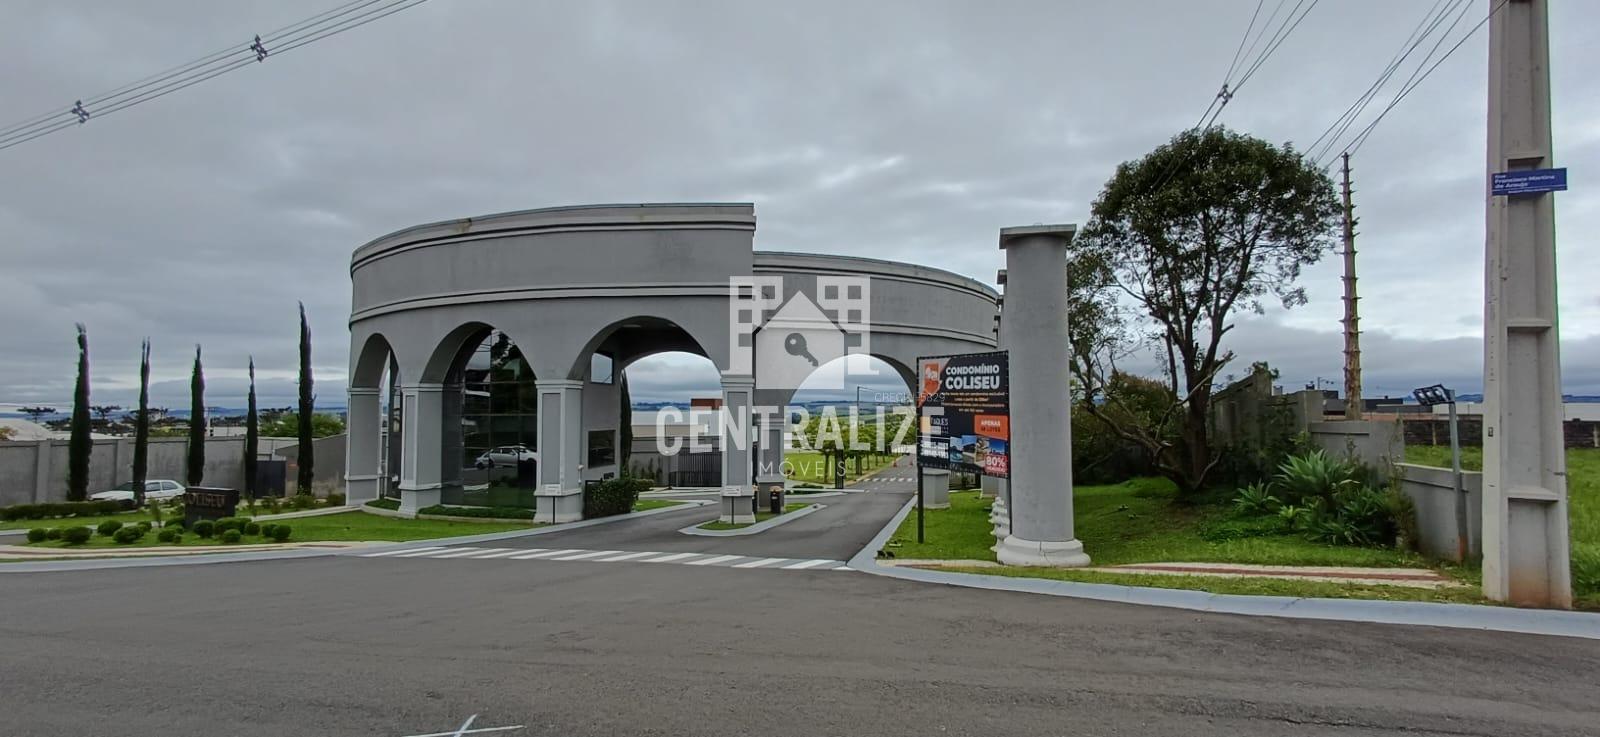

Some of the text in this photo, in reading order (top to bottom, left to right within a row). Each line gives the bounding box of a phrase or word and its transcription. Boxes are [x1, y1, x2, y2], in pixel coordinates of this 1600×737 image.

[945, 363, 1000, 375] CONDOMÍNIO
[945, 375, 1000, 390] COLISEU
[985, 455, 1006, 468] 80%
